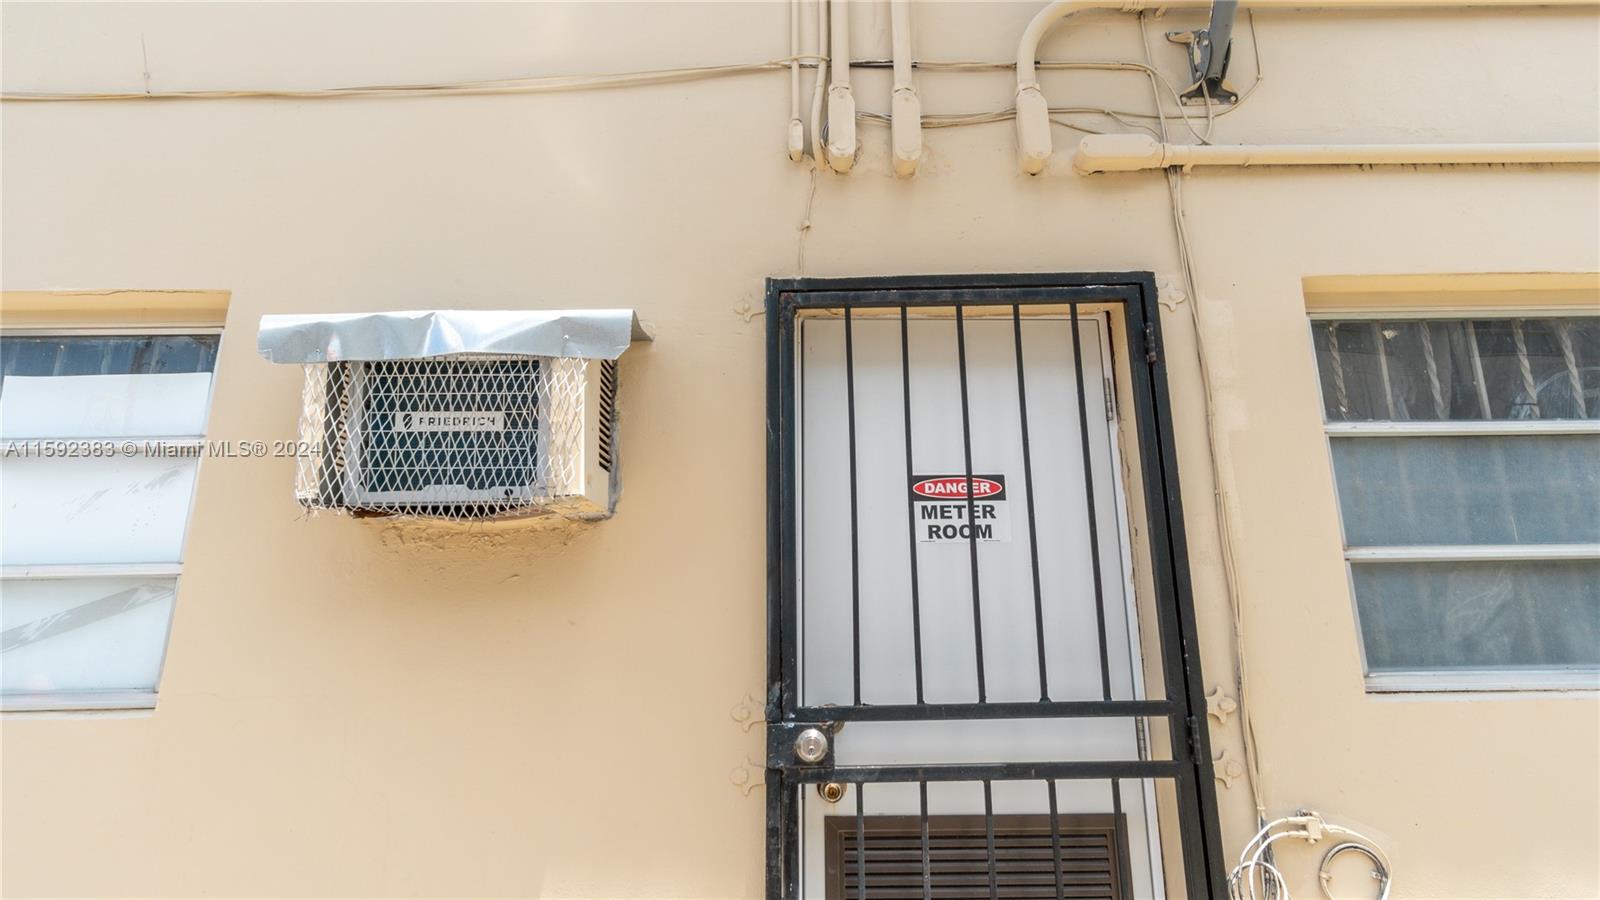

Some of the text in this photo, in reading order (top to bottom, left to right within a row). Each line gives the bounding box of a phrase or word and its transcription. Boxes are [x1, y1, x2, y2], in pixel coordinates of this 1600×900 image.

[418, 416, 496, 427] FRIEDRICH
[924, 482, 992, 494] DANGER
[920, 504, 997, 520] METER
[927, 524, 993, 540] ROOM
